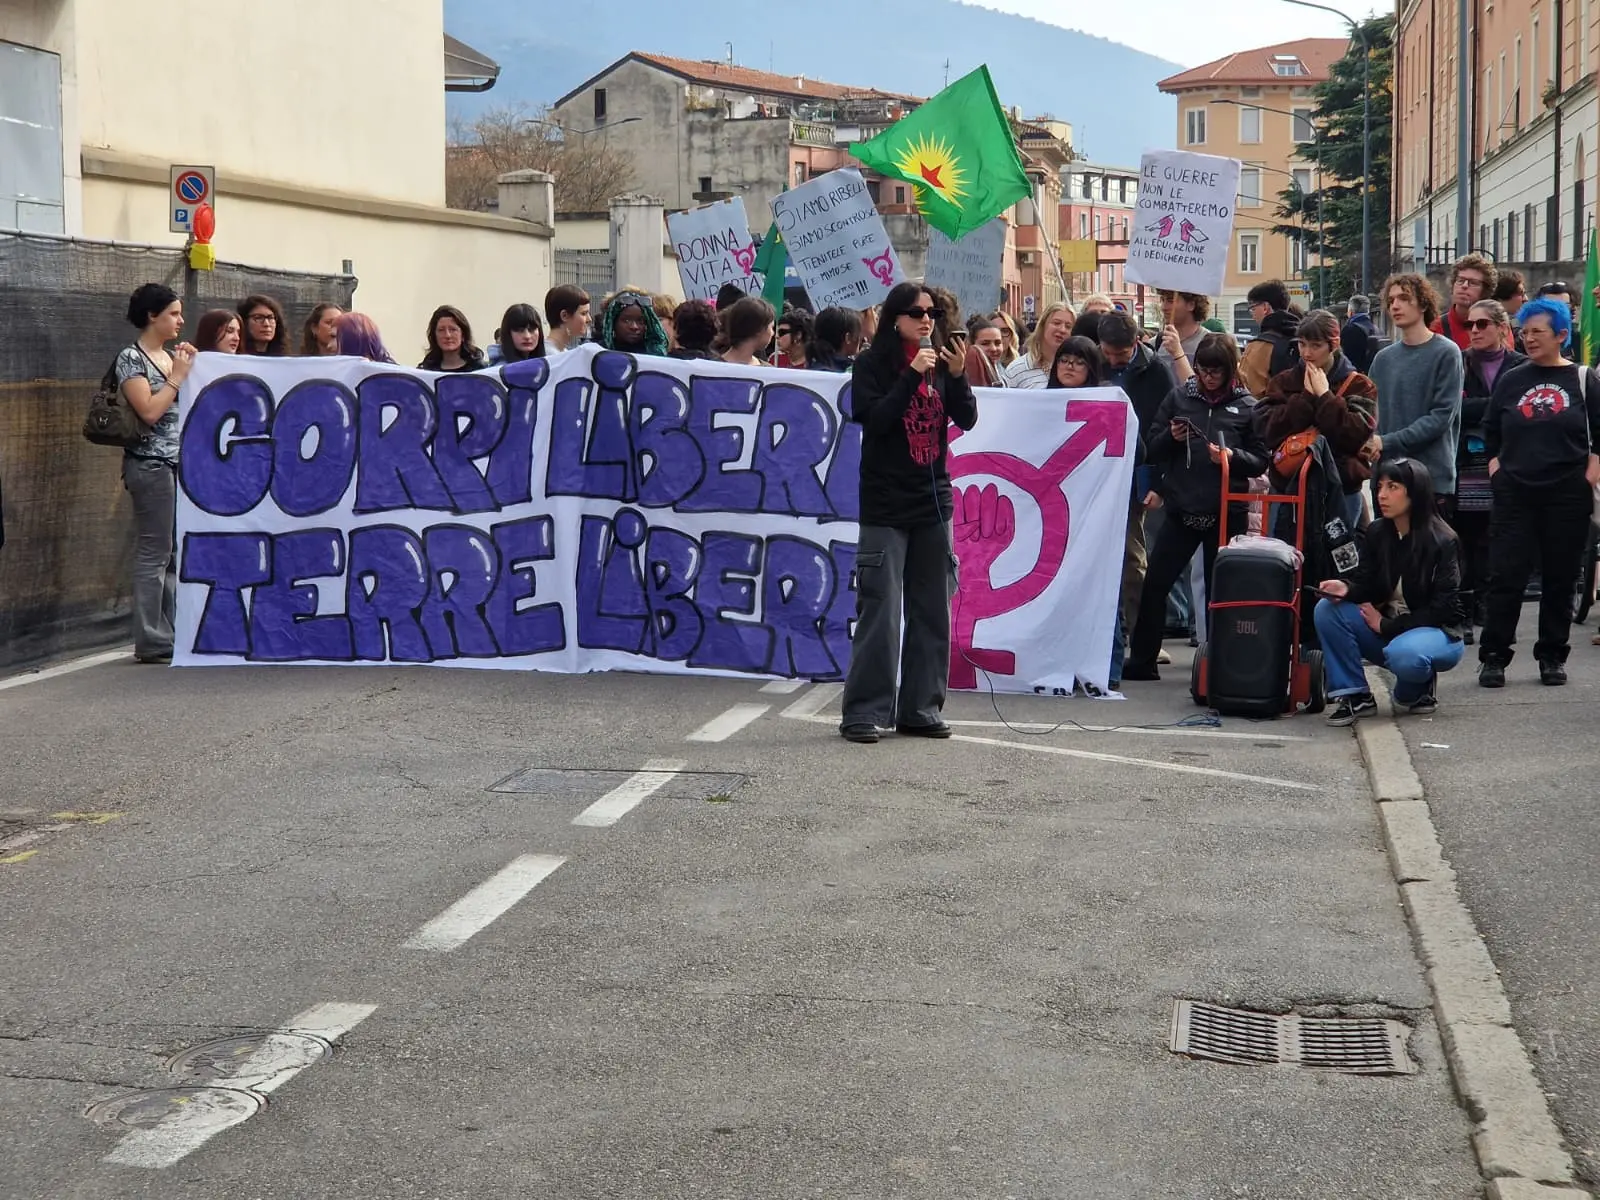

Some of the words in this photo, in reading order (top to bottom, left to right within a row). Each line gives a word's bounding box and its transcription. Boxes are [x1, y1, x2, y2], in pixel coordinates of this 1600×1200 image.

[1144, 165, 1157, 179] LE
[1164, 166, 1220, 187] GUERRE
[1142, 183, 1162, 196] NON
[1170, 188, 1183, 199] LE
[774, 196, 830, 231] SIAMO
[1139, 198, 1228, 218] COMBATTEREMO
[678, 227, 740, 263] DONNA
[789, 227, 824, 252] SIAMO
[1152, 238, 1205, 254] EDUCAZIONE
[685, 257, 733, 285] VITA
[819, 262, 853, 281] MIMOSE
[180, 514, 565, 662] TERRE
[1237, 620, 1258, 634] JBL
